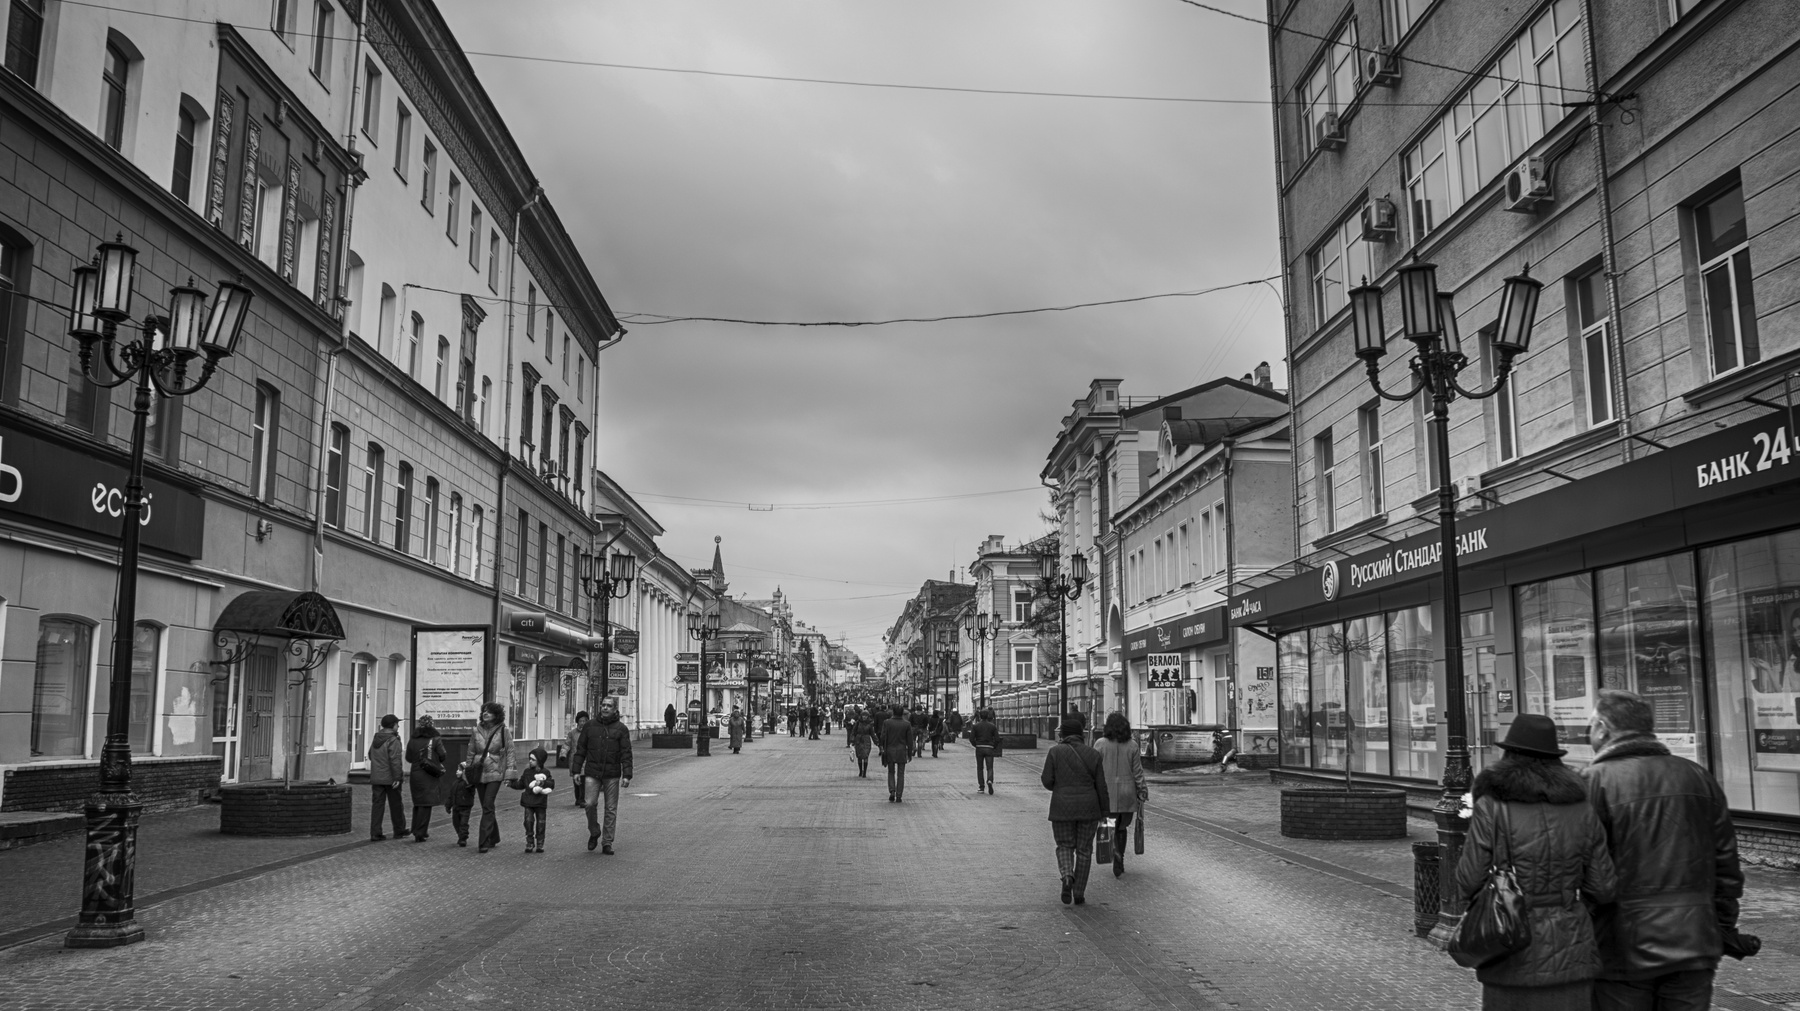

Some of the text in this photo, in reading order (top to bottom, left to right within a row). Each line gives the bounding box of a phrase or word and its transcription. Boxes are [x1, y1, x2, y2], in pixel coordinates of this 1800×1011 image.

[1697, 426, 1791, 488] БАНК 24
[92, 483, 152, 525] eco
[1455, 528, 1488, 557] БАНК
[1230, 599, 1262, 619] БАНК 24 ЧАСА
[521, 619, 534, 627] citi
[1182, 626, 1193, 638] САЛОН
[1194, 622, 1206, 635] ОБУВИ
